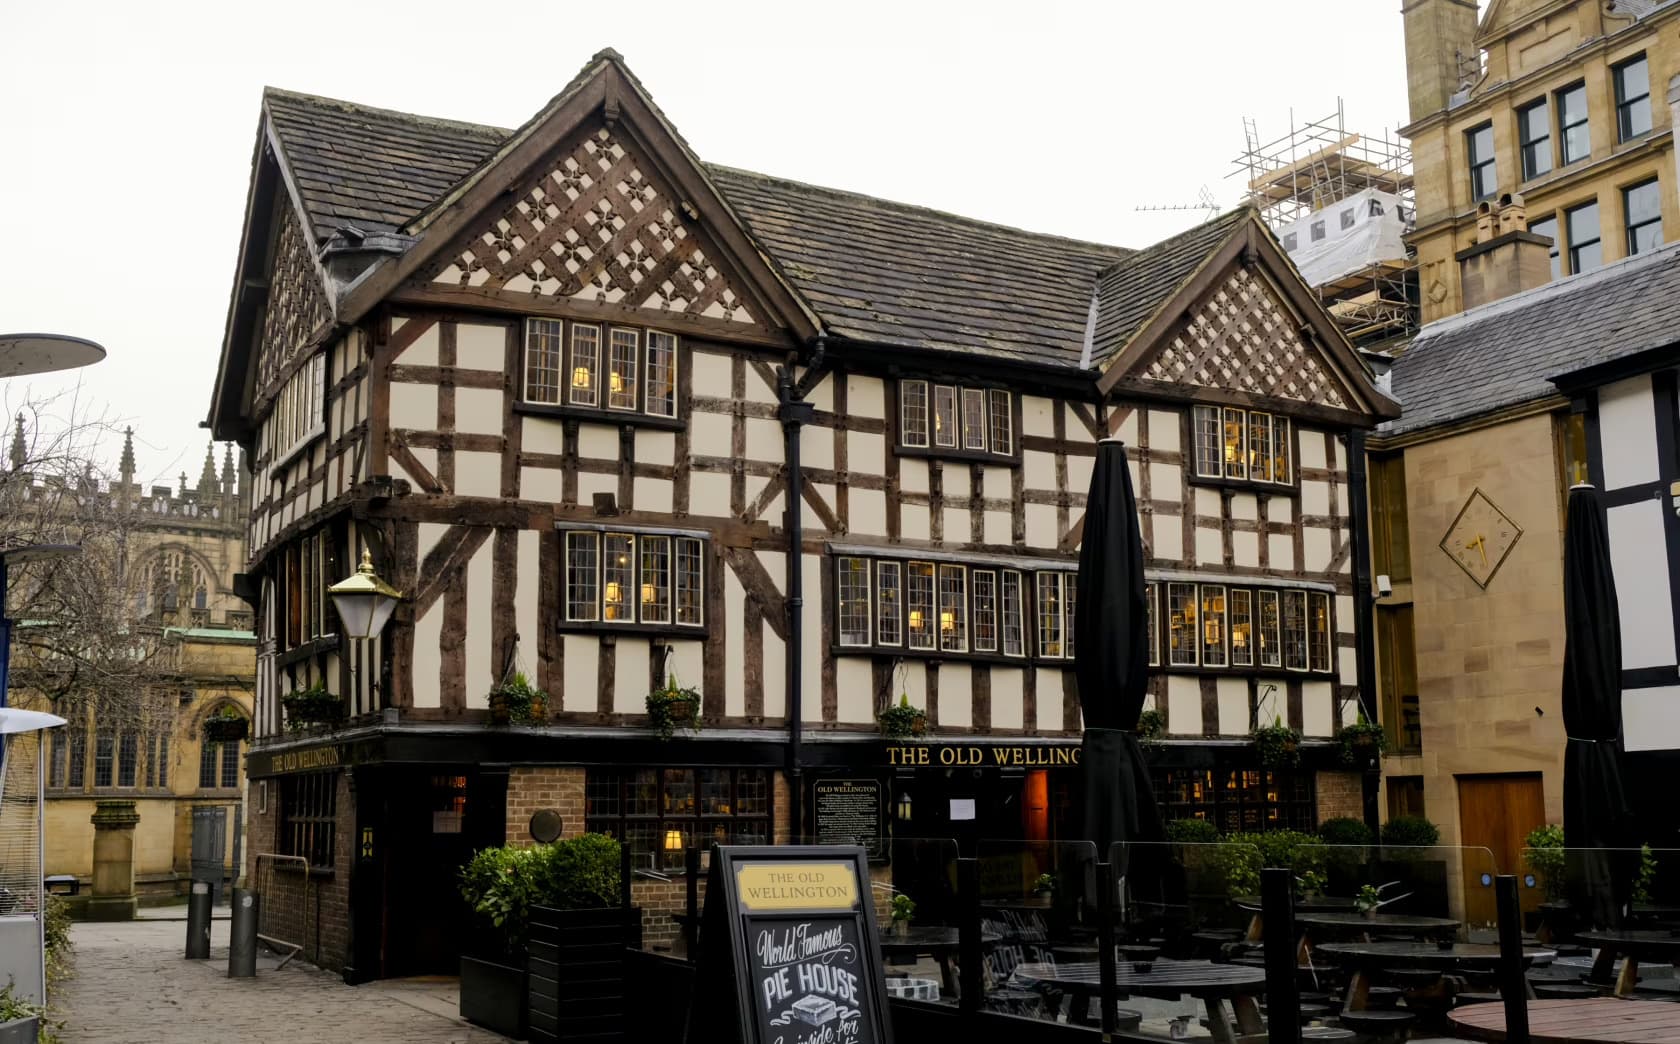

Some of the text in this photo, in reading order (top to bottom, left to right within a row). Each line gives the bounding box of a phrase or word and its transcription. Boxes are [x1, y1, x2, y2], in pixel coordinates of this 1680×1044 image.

[271, 747, 339, 773] THE OLD WELLINGTON
[886, 747, 930, 765] THE
[940, 747, 983, 765] OLD
[768, 872, 825, 884] THE OLD
[747, 886, 848, 899] WELLINGTON
[757, 923, 843, 966] World Famous
[763, 963, 860, 1010] PIE HOUSE
[836, 1019, 859, 1042] for
